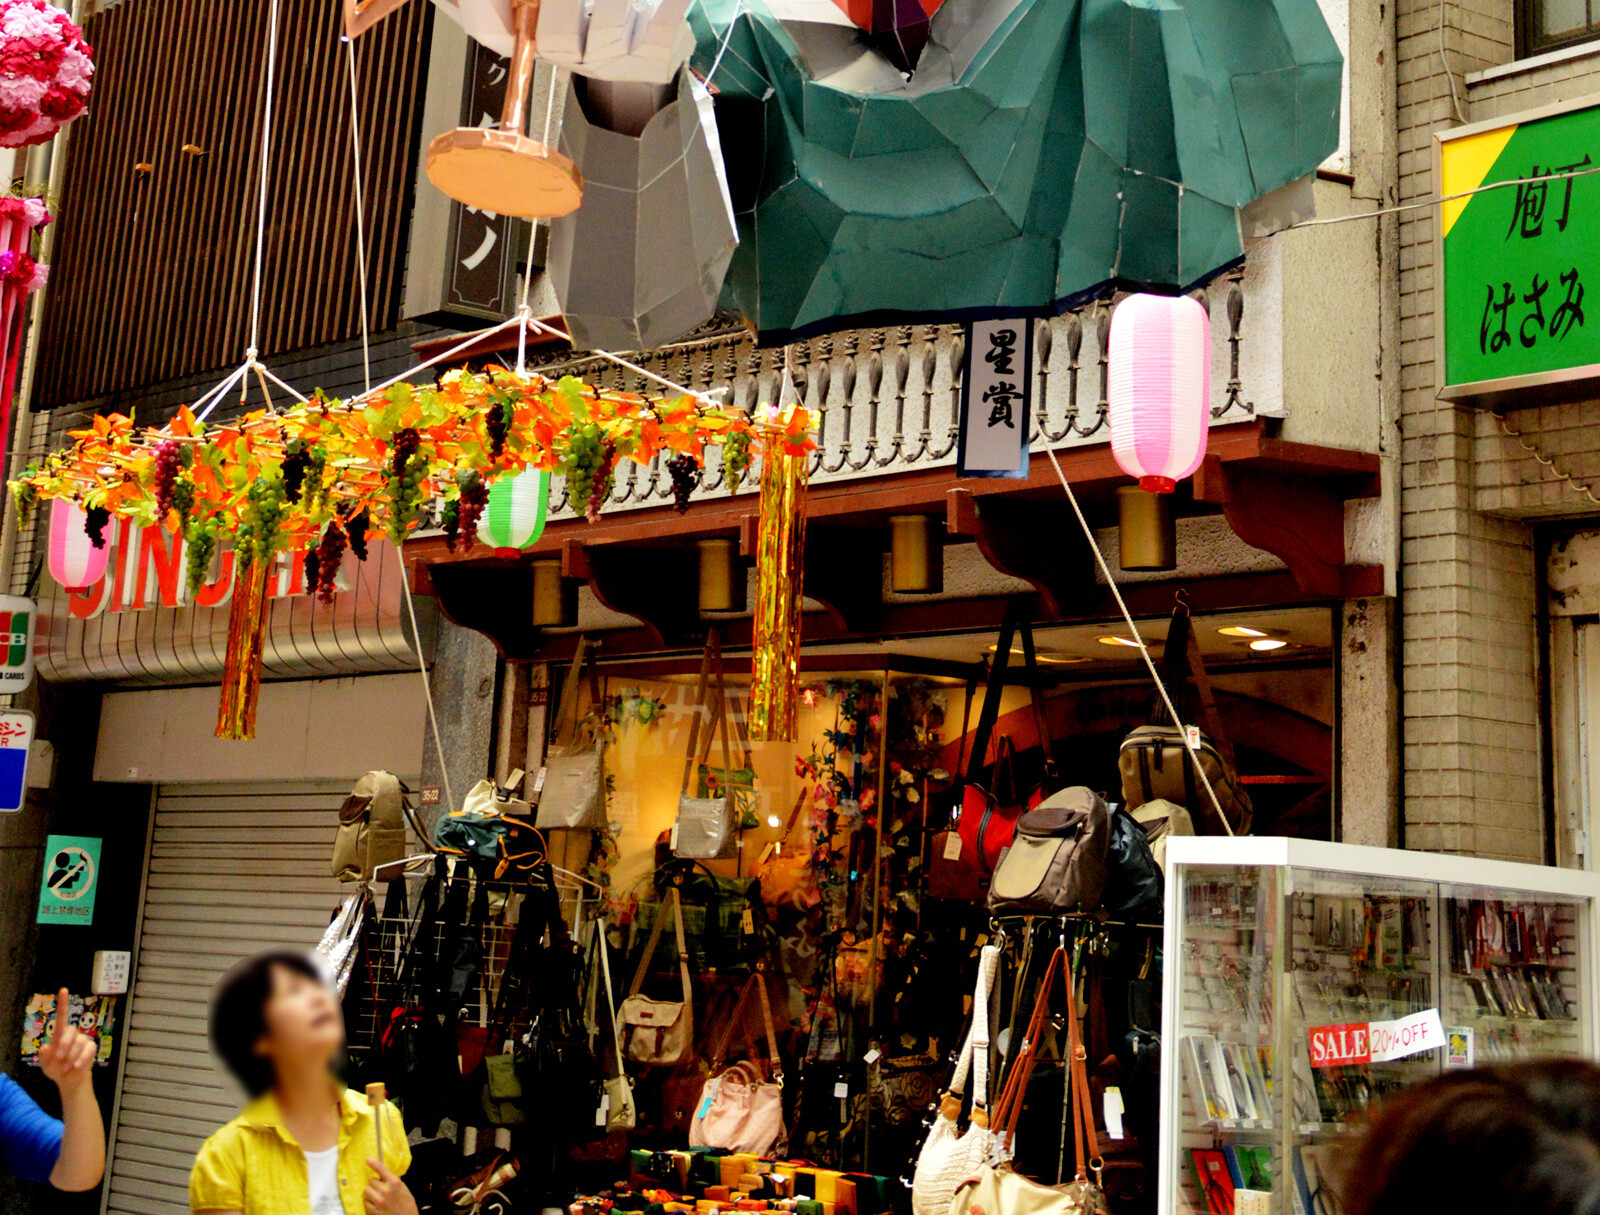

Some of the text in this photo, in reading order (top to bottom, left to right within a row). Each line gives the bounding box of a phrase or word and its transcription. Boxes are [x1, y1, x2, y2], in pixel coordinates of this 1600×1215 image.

[1505, 153, 1592, 242] 庖丁
[1479, 266, 1585, 356] はさみ
[981, 328, 1024, 430] 星賞
[1313, 1022, 1429, 1061] SALE 20% OFF
